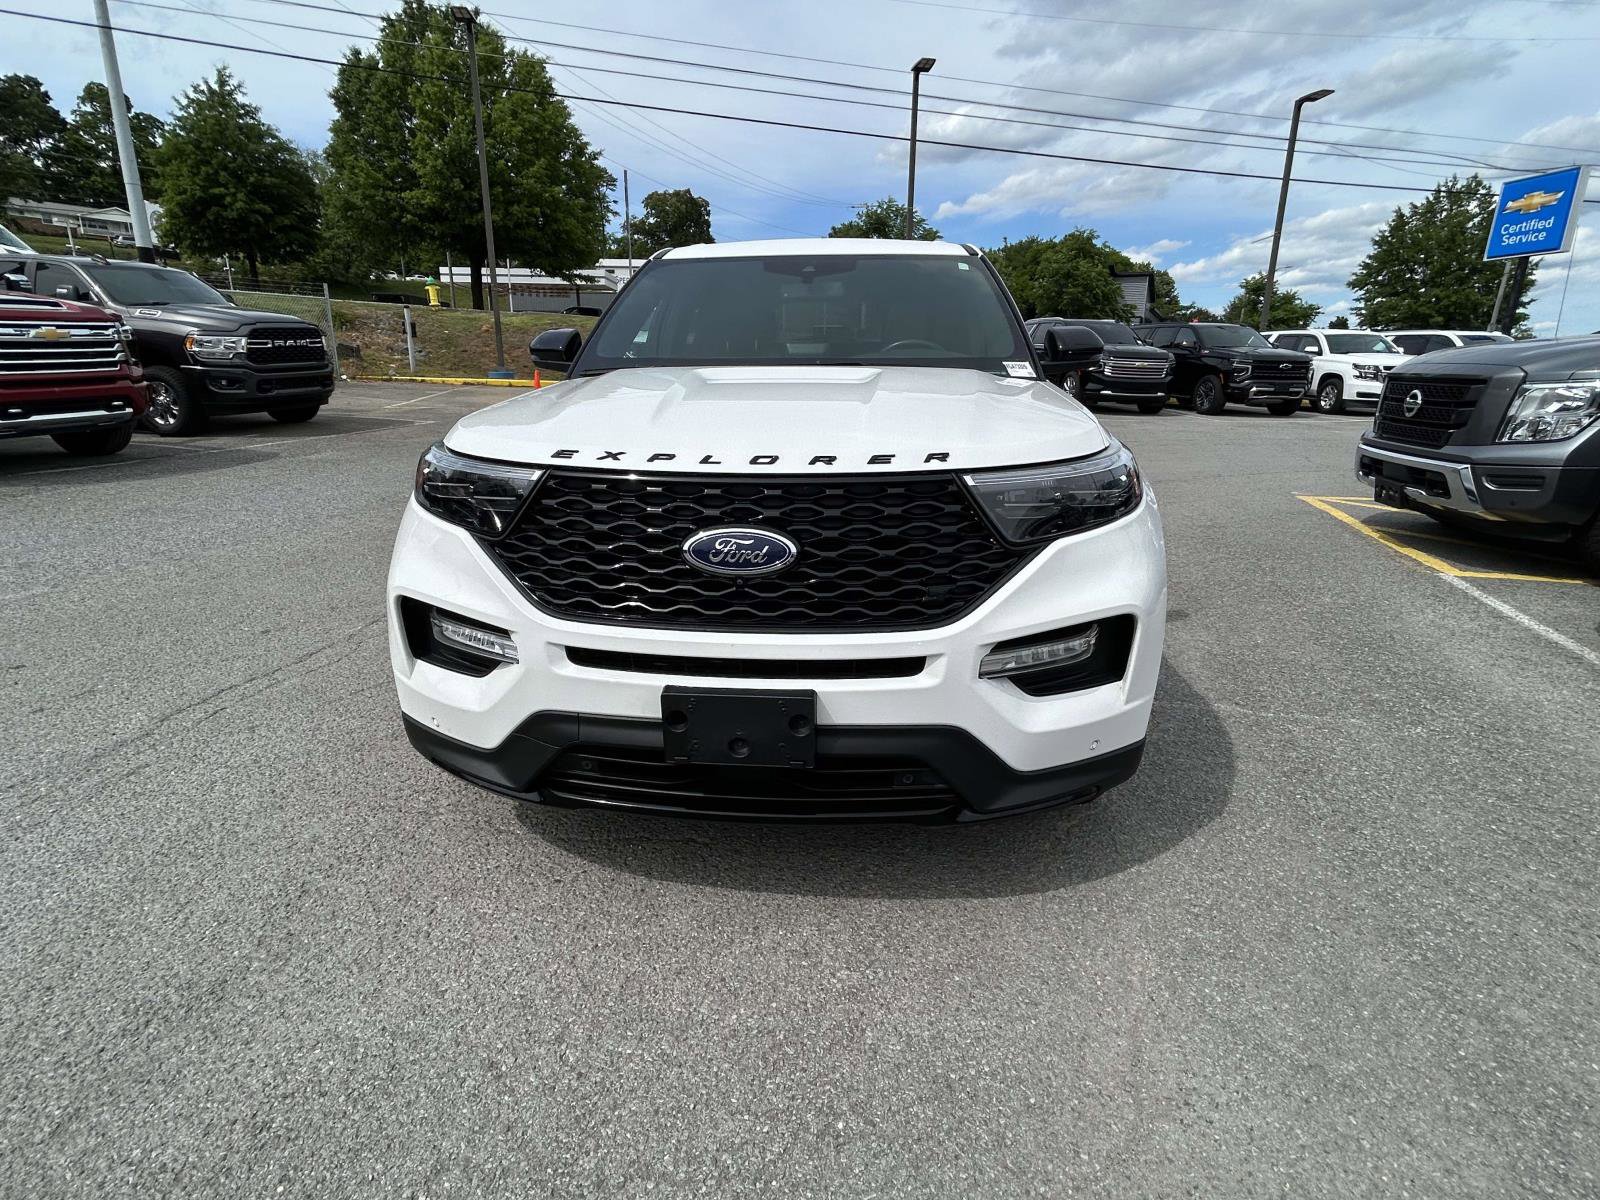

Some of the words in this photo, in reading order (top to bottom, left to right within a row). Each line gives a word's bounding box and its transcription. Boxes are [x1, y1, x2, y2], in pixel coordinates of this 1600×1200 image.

[1501, 216, 1555, 235] Certified
[1501, 231, 1547, 246] Service
[550, 449, 950, 466] EXPLORER
[709, 538, 769, 563] Ford
